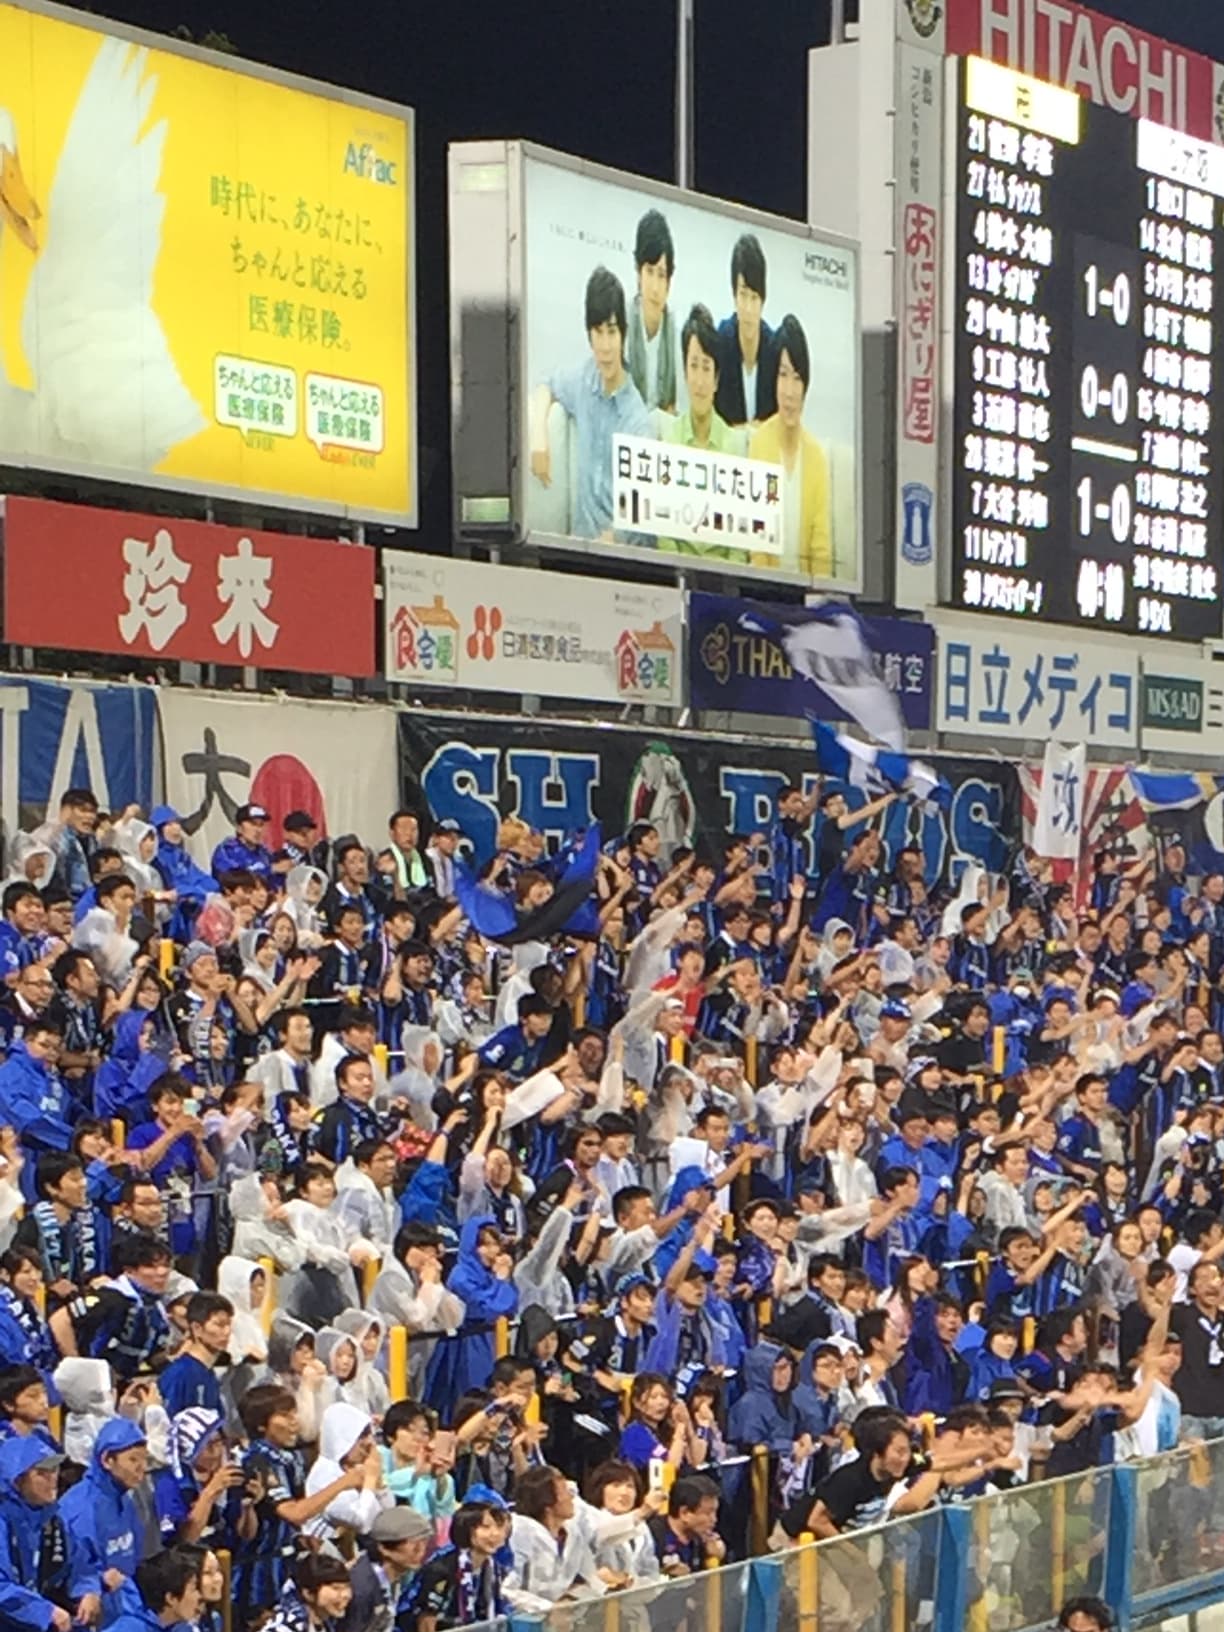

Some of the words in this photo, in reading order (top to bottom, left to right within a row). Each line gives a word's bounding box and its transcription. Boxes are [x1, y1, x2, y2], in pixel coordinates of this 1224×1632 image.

[982, 0, 1187, 134] HITACHI
[211, 175, 383, 255] 時代に、あなたに、
[230, 235, 367, 300] ちゃんと応える
[1085, 265, 1130, 326] 1-0
[906, 205, 935, 441] おにぎり屋
[1081, 365, 1128, 424] 0-0
[618, 445, 780, 506] 日立はエコにたし算
[1078, 477, 1130, 543] 1-0
[945, 642, 1133, 735] 日立メディコ
